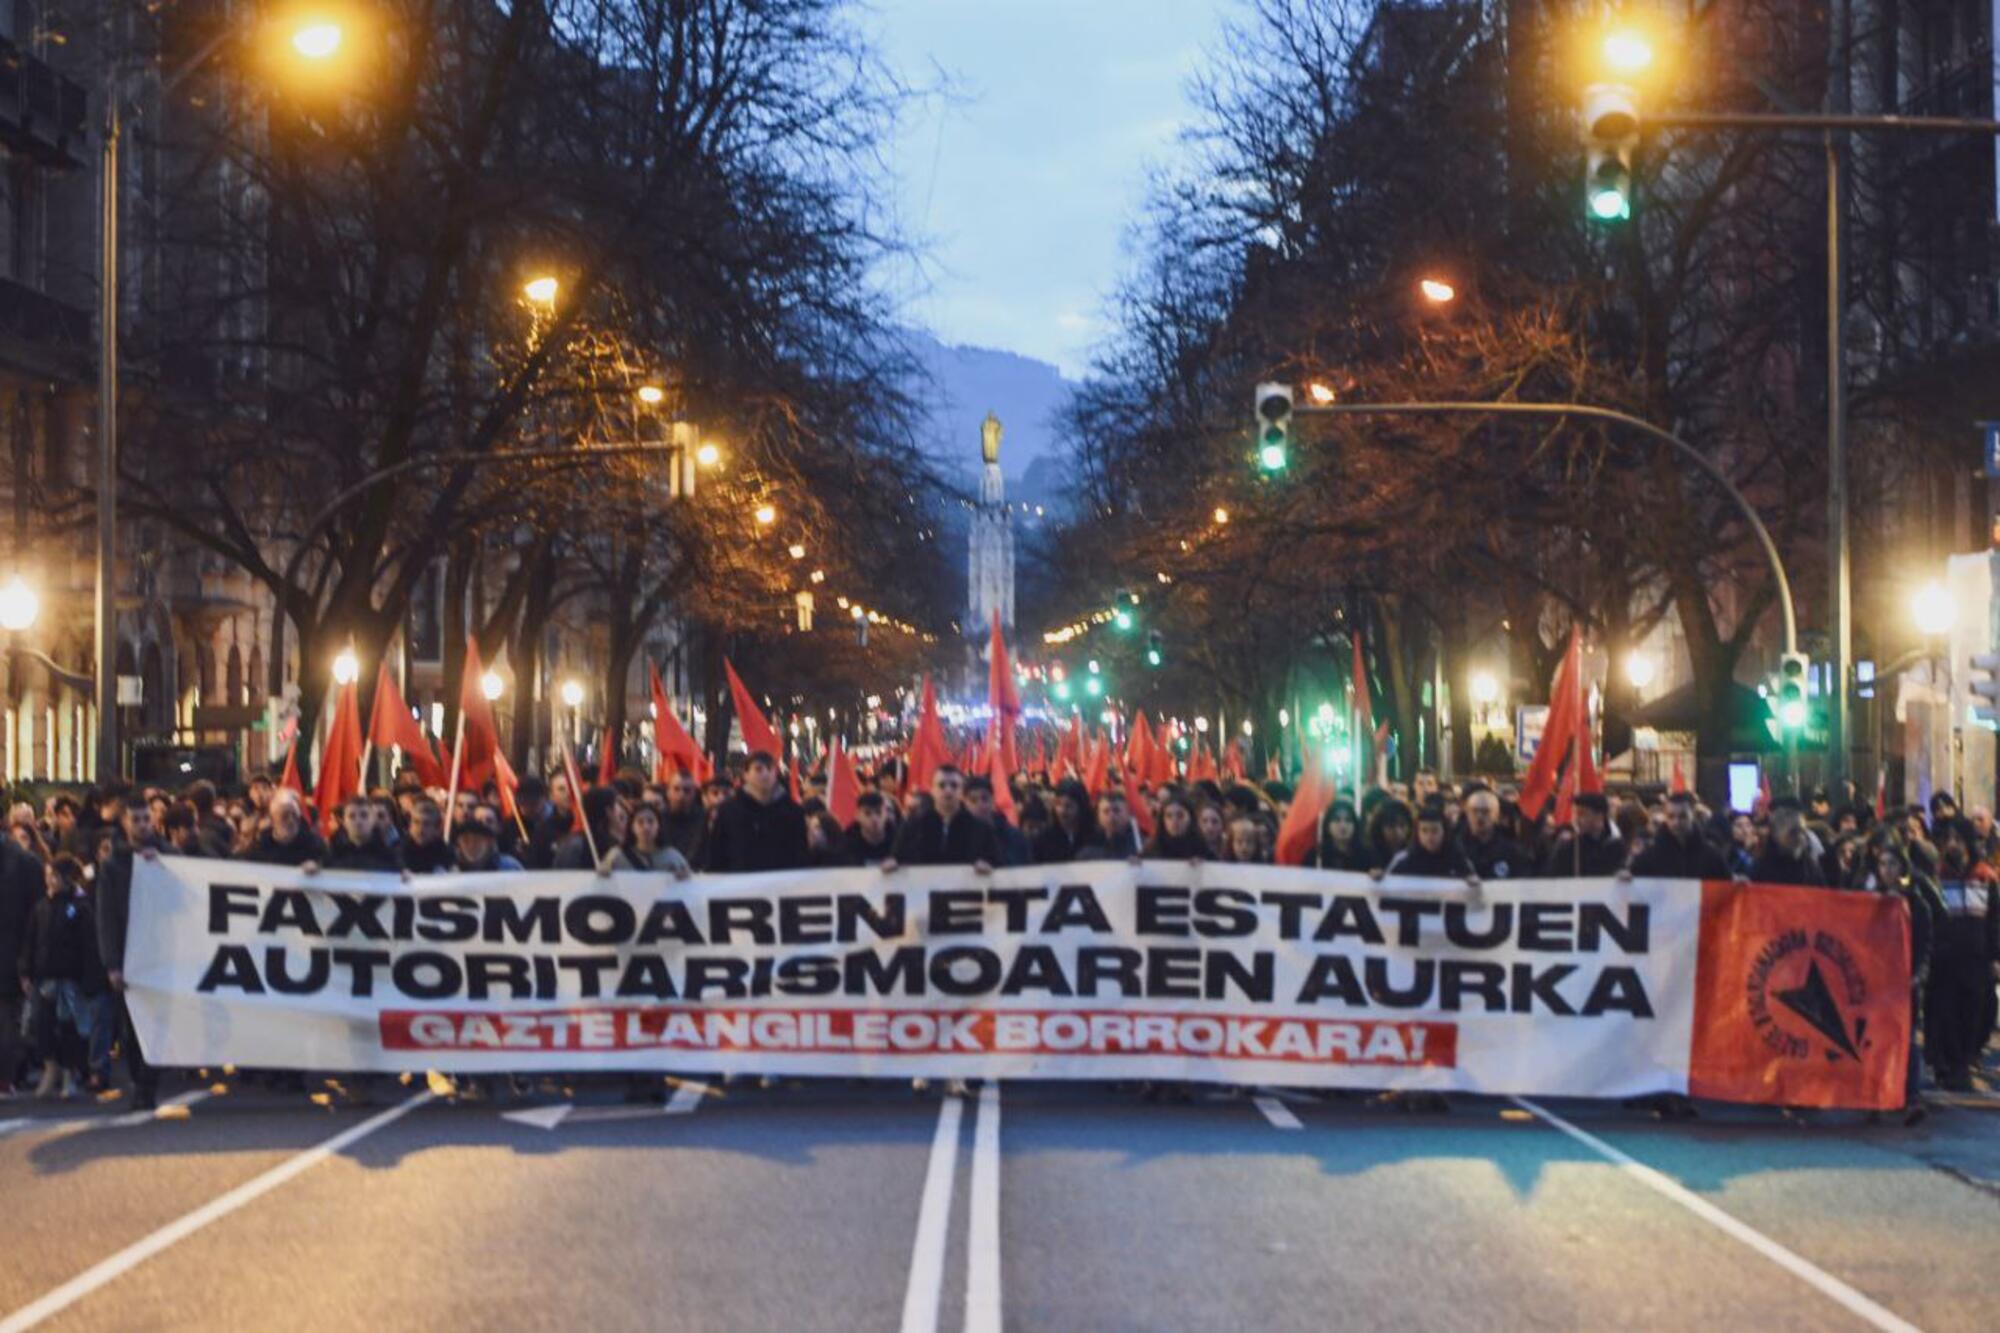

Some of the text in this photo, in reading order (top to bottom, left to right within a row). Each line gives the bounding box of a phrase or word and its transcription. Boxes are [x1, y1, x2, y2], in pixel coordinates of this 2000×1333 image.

[208, 884, 1650, 954] FAXISMOAREN ETA ESTATUEN
[197, 944, 1655, 1018] AUTORITARISMOAREN AURKA
[409, 1012, 1425, 1060] GAZTE LANGILEOK BORROKARA!
